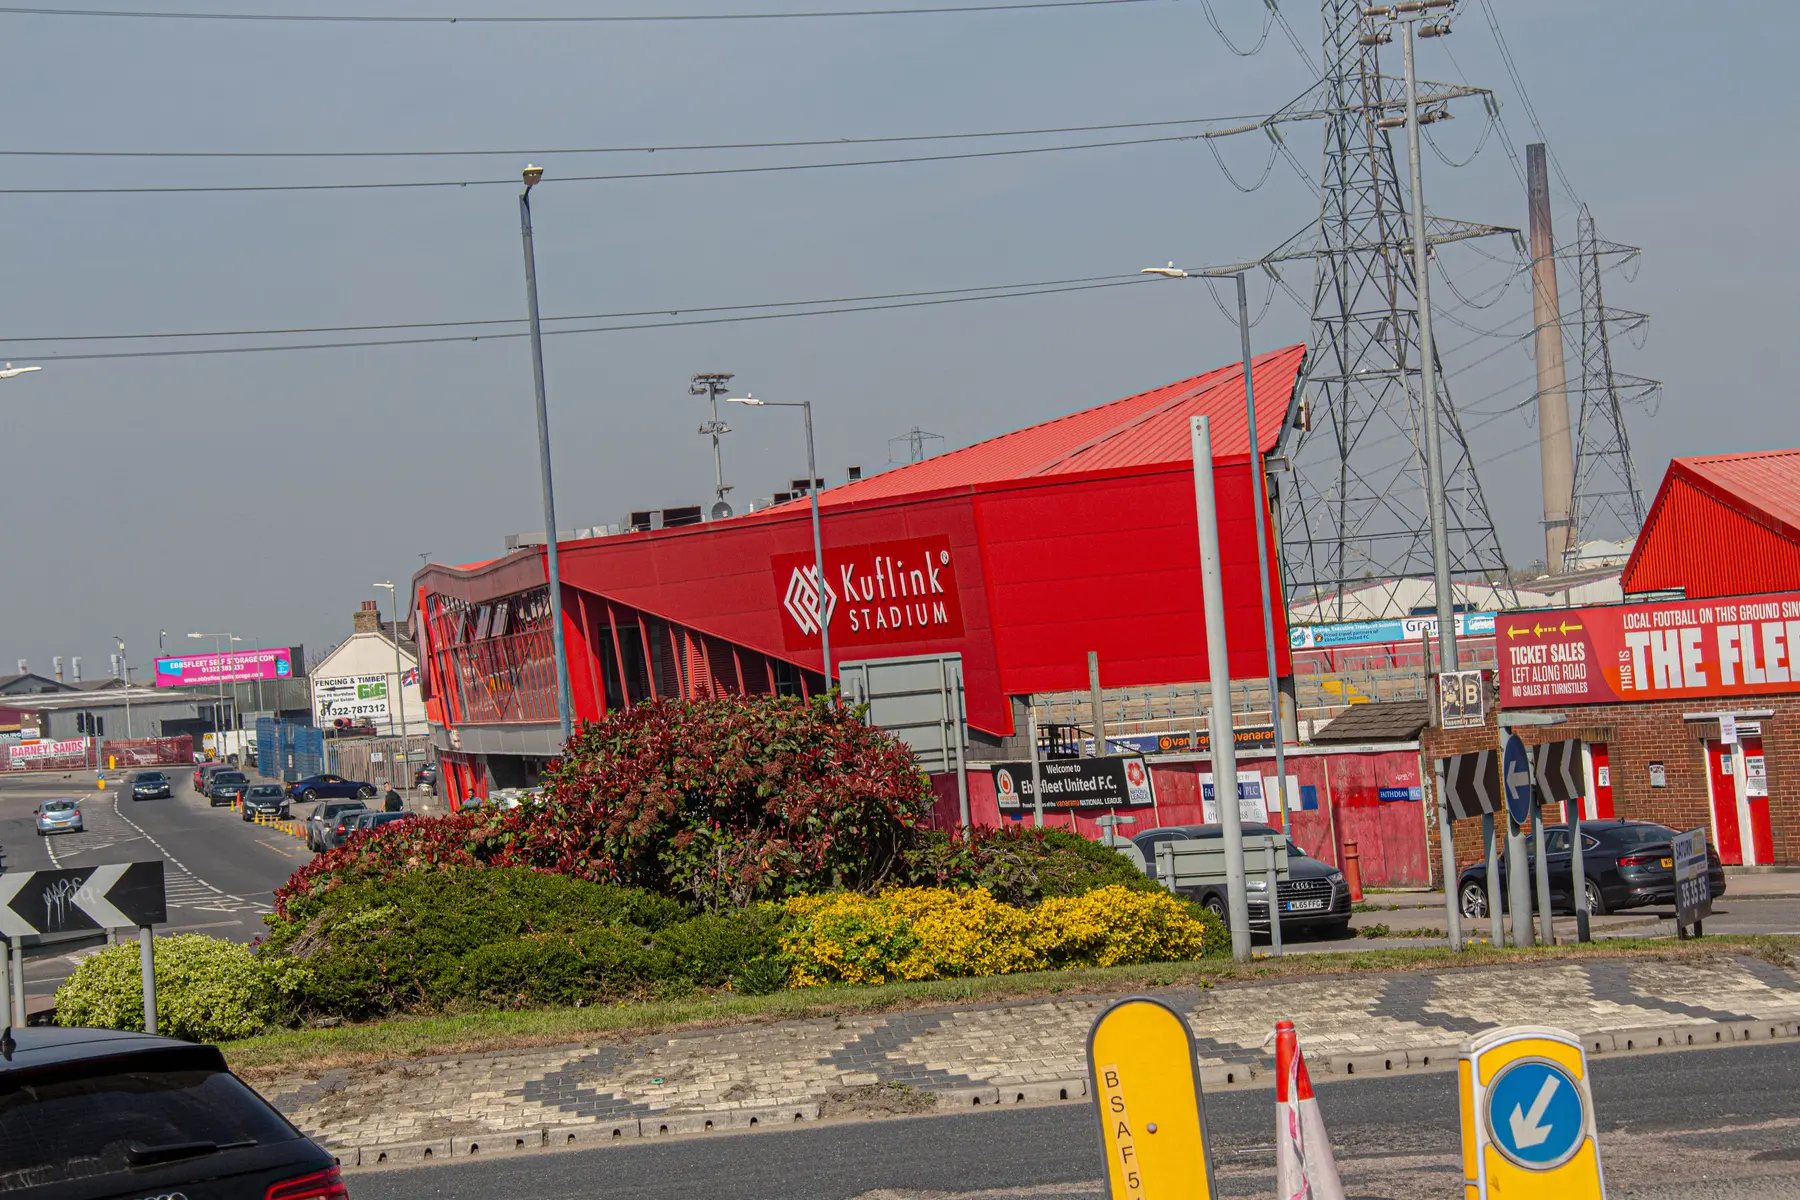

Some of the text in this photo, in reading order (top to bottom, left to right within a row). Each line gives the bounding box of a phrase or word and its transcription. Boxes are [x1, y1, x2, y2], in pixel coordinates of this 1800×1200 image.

[849, 601, 948, 632] STADIUM
[1623, 601, 1800, 629] LOCAL FOOTBALL ON THIS GROUND SIN
[1406, 618, 1460, 632] Grae
[1509, 642, 1585, 665] TICKET SALES
[1624, 627, 1707, 691] THE
[170, 660, 207, 669] EBBSFLEET
[209, 658, 225, 666] SEF
[1618, 650, 1633, 691] THIS IS
[315, 679, 348, 687] FENCING
[358, 675, 386, 683] TIMBER
[1511, 663, 1586, 683] LEFT ALONG ROAD
[1465, 684, 1478, 705] B
[1512, 682, 1588, 697] NO SALES AT TURNSTILES
[1171, 735, 1210, 746] vanra
[1236, 730, 1275, 741] vanara
[11, 745, 48, 757] BARNEY
[53, 741, 83, 753] SANDS
[1046, 763, 1081, 774] Welcome to
[1021, 778, 1063, 794] Ebsfleet
[1064, 776, 1096, 792] United
[1245, 786, 1259, 796] PLC
[1080, 798, 1103, 806] NATIONAL
[1676, 838, 1693, 860] SATURN
[1681, 876, 1707, 908] 35 35 35
[1104, 1070, 1140, 1200] BSAF5
